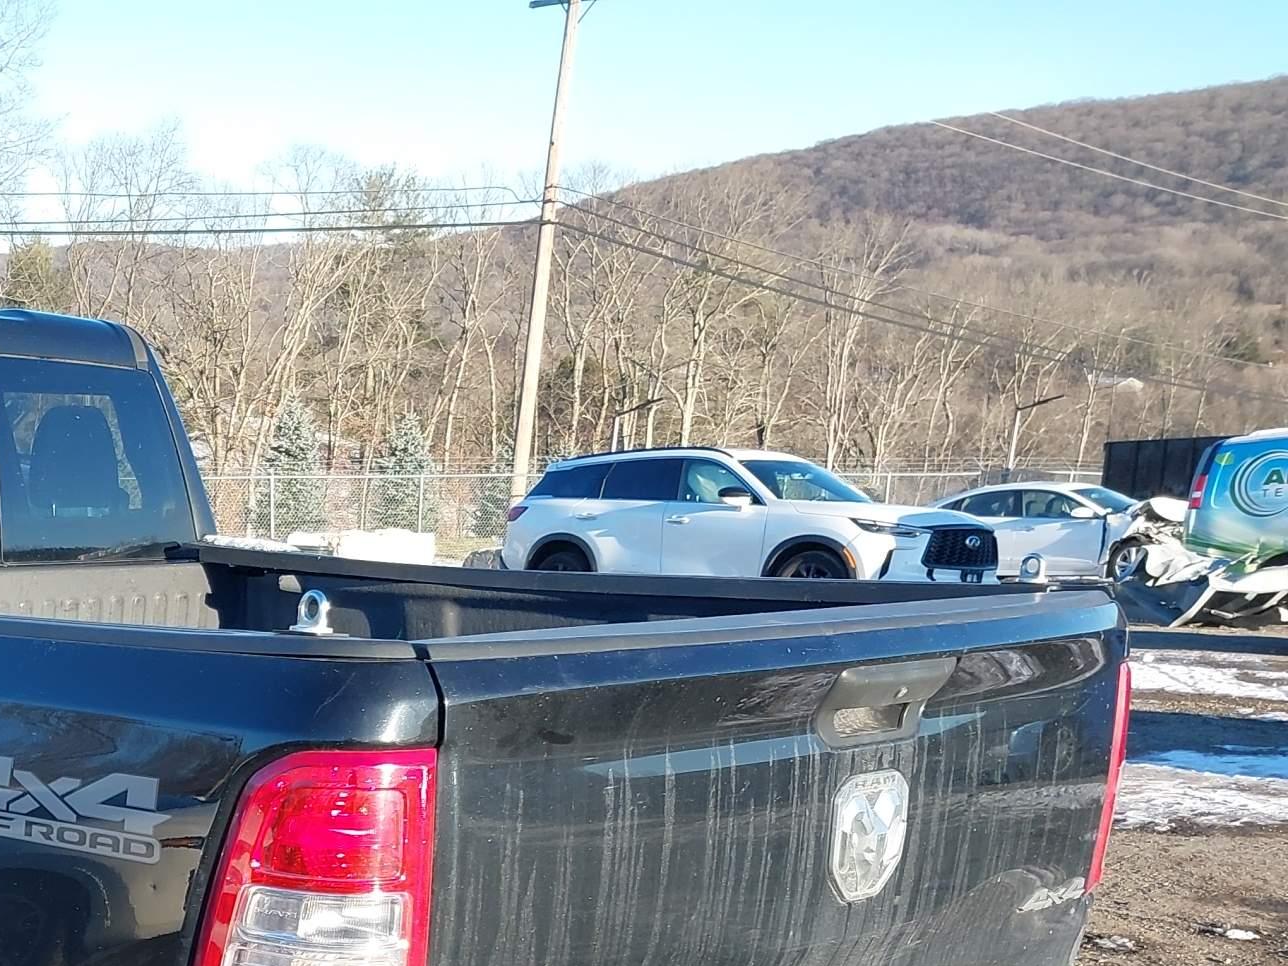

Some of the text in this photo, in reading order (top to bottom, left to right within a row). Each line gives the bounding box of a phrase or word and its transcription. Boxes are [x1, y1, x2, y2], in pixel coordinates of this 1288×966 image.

[1263, 468, 1288, 485] A
[855, 774, 898, 789] RAM
[23, 819, 156, 860] ROAD
